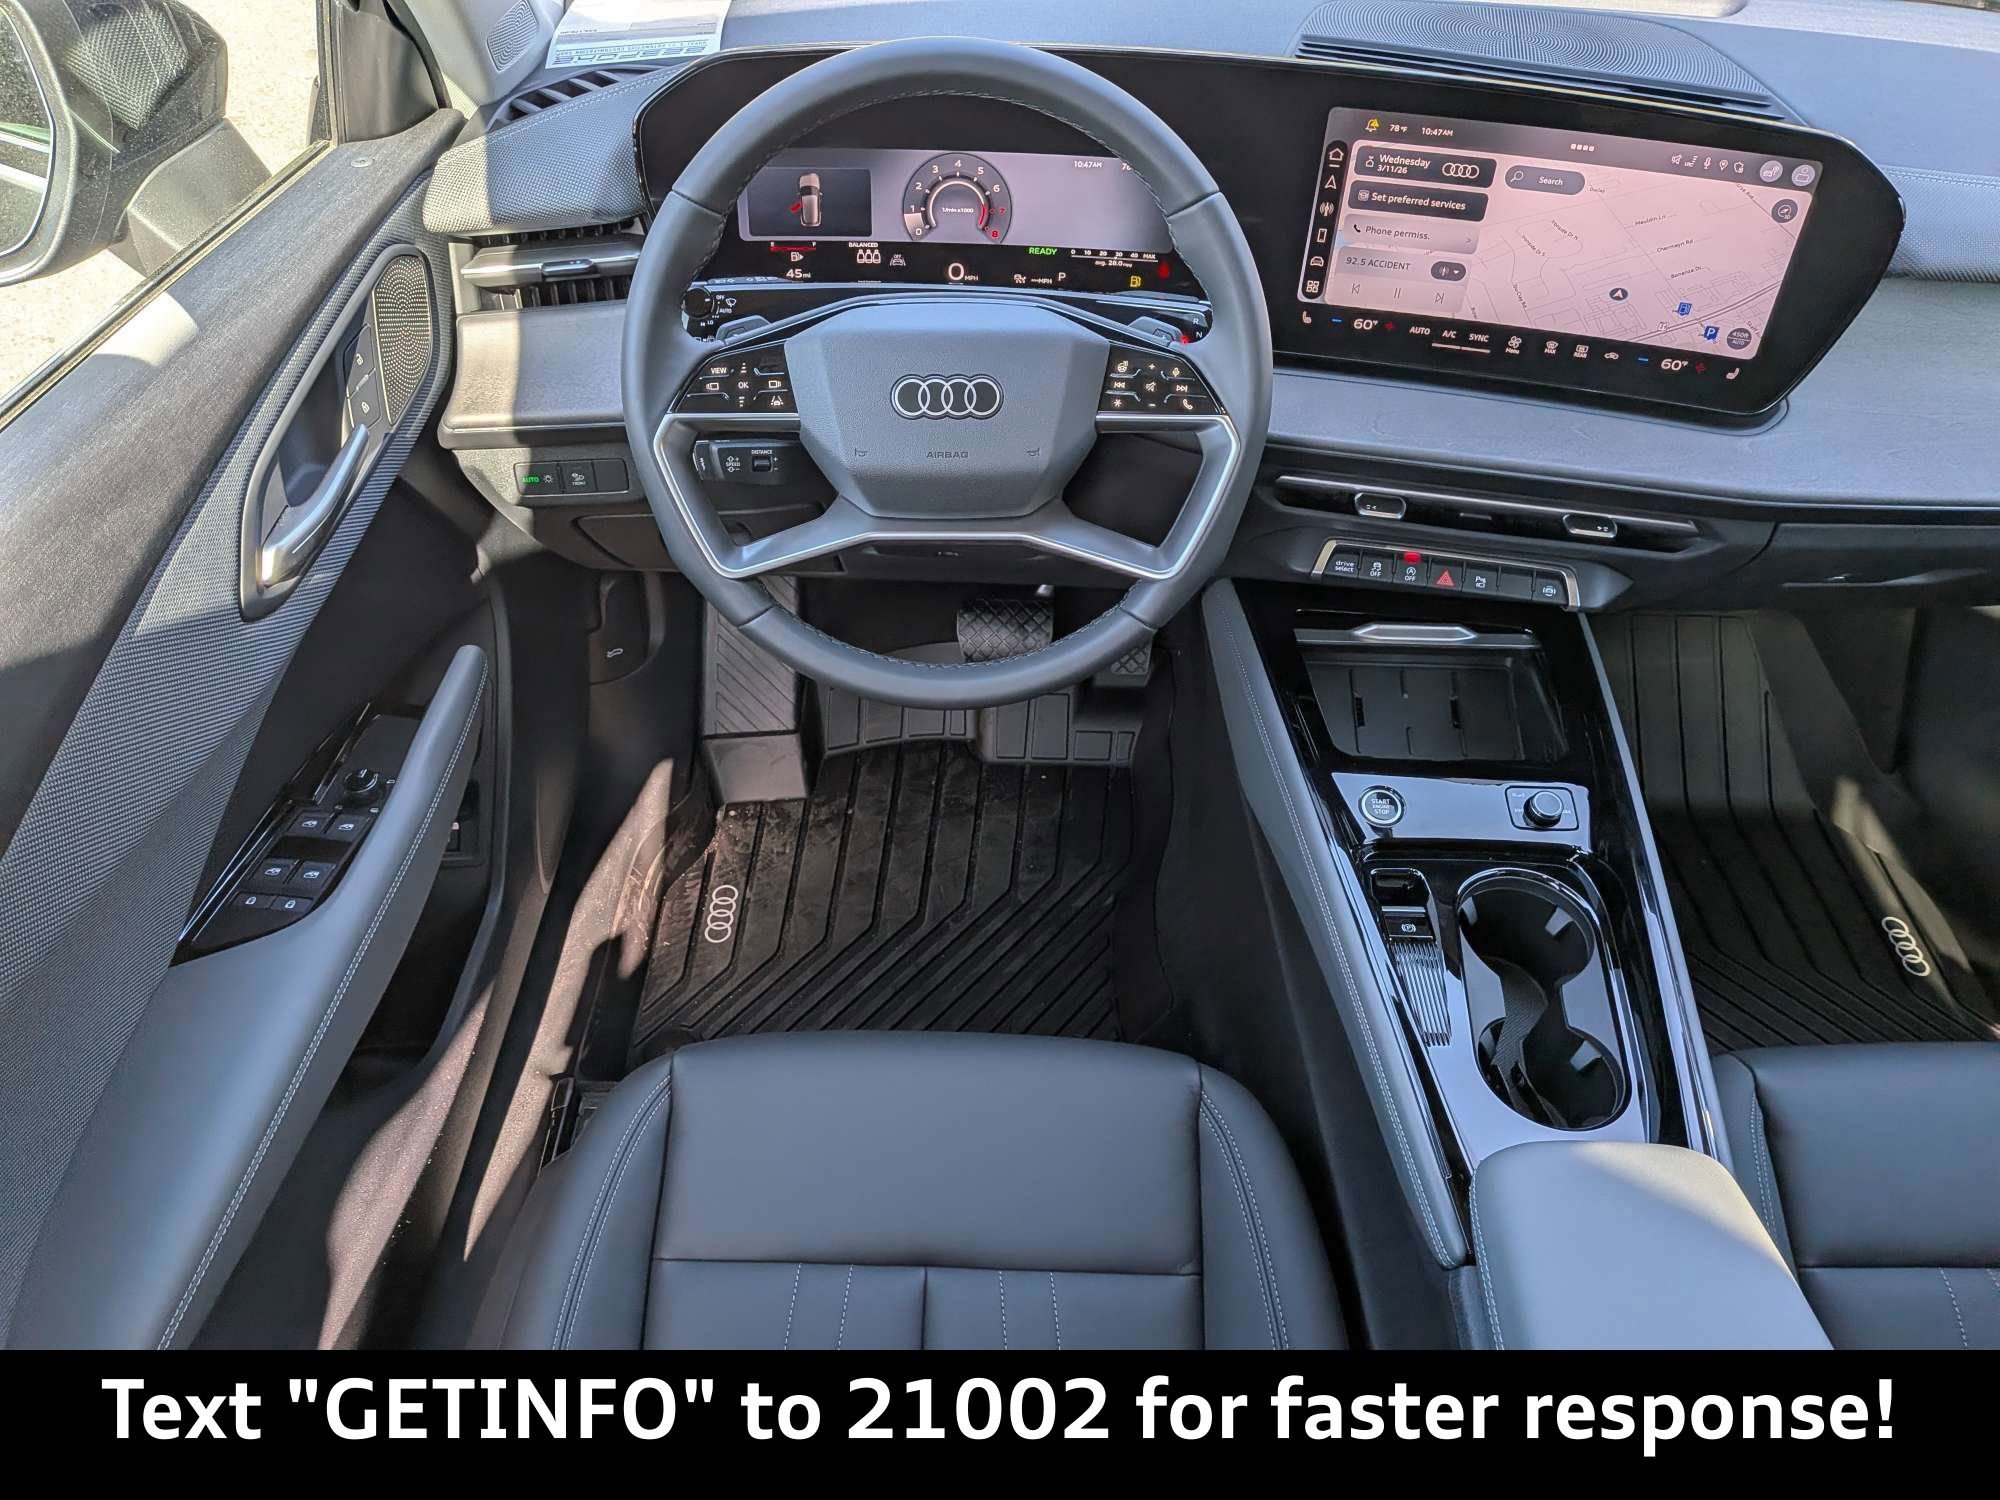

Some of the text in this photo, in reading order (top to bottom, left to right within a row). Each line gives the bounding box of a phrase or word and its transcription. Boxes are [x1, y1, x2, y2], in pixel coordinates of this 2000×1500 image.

[1421, 127, 1454, 136] 10:47AM
[955, 159, 962, 167] 4
[1073, 160, 1103, 169] 10:47AM
[1379, 154, 1431, 169] Wednesday
[932, 165, 939, 174] 3
[977, 166, 984, 175] 5
[1377, 164, 1408, 174] 3/11/26
[1538, 175, 1564, 186] Search
[915, 182, 922, 190] 2
[993, 184, 1000, 193] 6
[1371, 192, 1466, 210] Set preferred services
[910, 204, 915, 213] 1
[915, 228, 922, 236] 0
[991, 230, 999, 238] 8
[1365, 225, 1431, 241] Phone permiss.
[1028, 246, 1058, 255] READY
[1345, 256, 1411, 271] 92.5 ACCIDENT
[947, 262, 965, 281] 0
[1058, 272, 1066, 281] P
[1192, 317, 1199, 325] R
[1409, 326, 1431, 335] AUTO
[1442, 329, 1457, 339] A/C
[1468, 333, 1490, 342] SYNC
[738, 381, 749, 389] OK
[926, 451, 969, 459] AIRBAG
[1334, 565, 1354, 573] select
